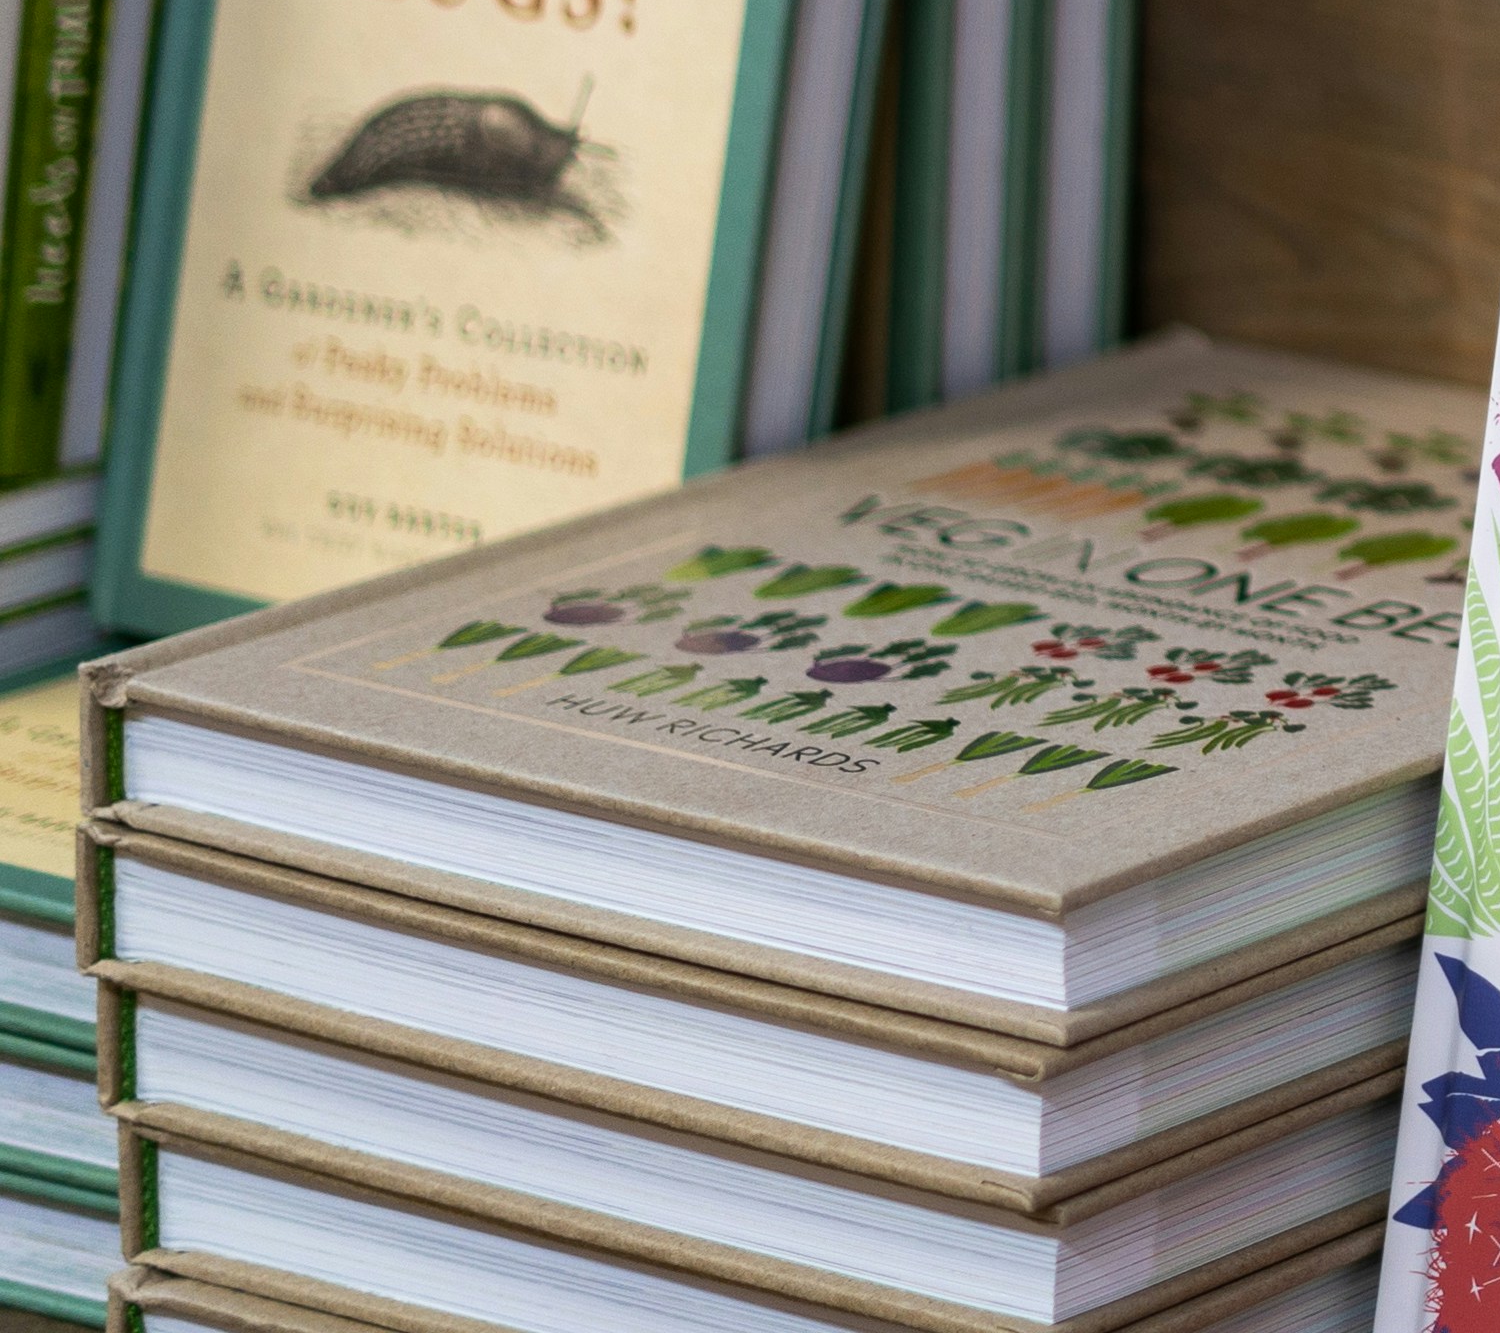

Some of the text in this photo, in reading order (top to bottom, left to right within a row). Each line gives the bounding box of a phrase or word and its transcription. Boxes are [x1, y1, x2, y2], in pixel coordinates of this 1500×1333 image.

[1123, 556, 1356, 618] ONE
[1329, 599, 1465, 650] BE
[545, 692, 882, 774] HUW RICHARDS
